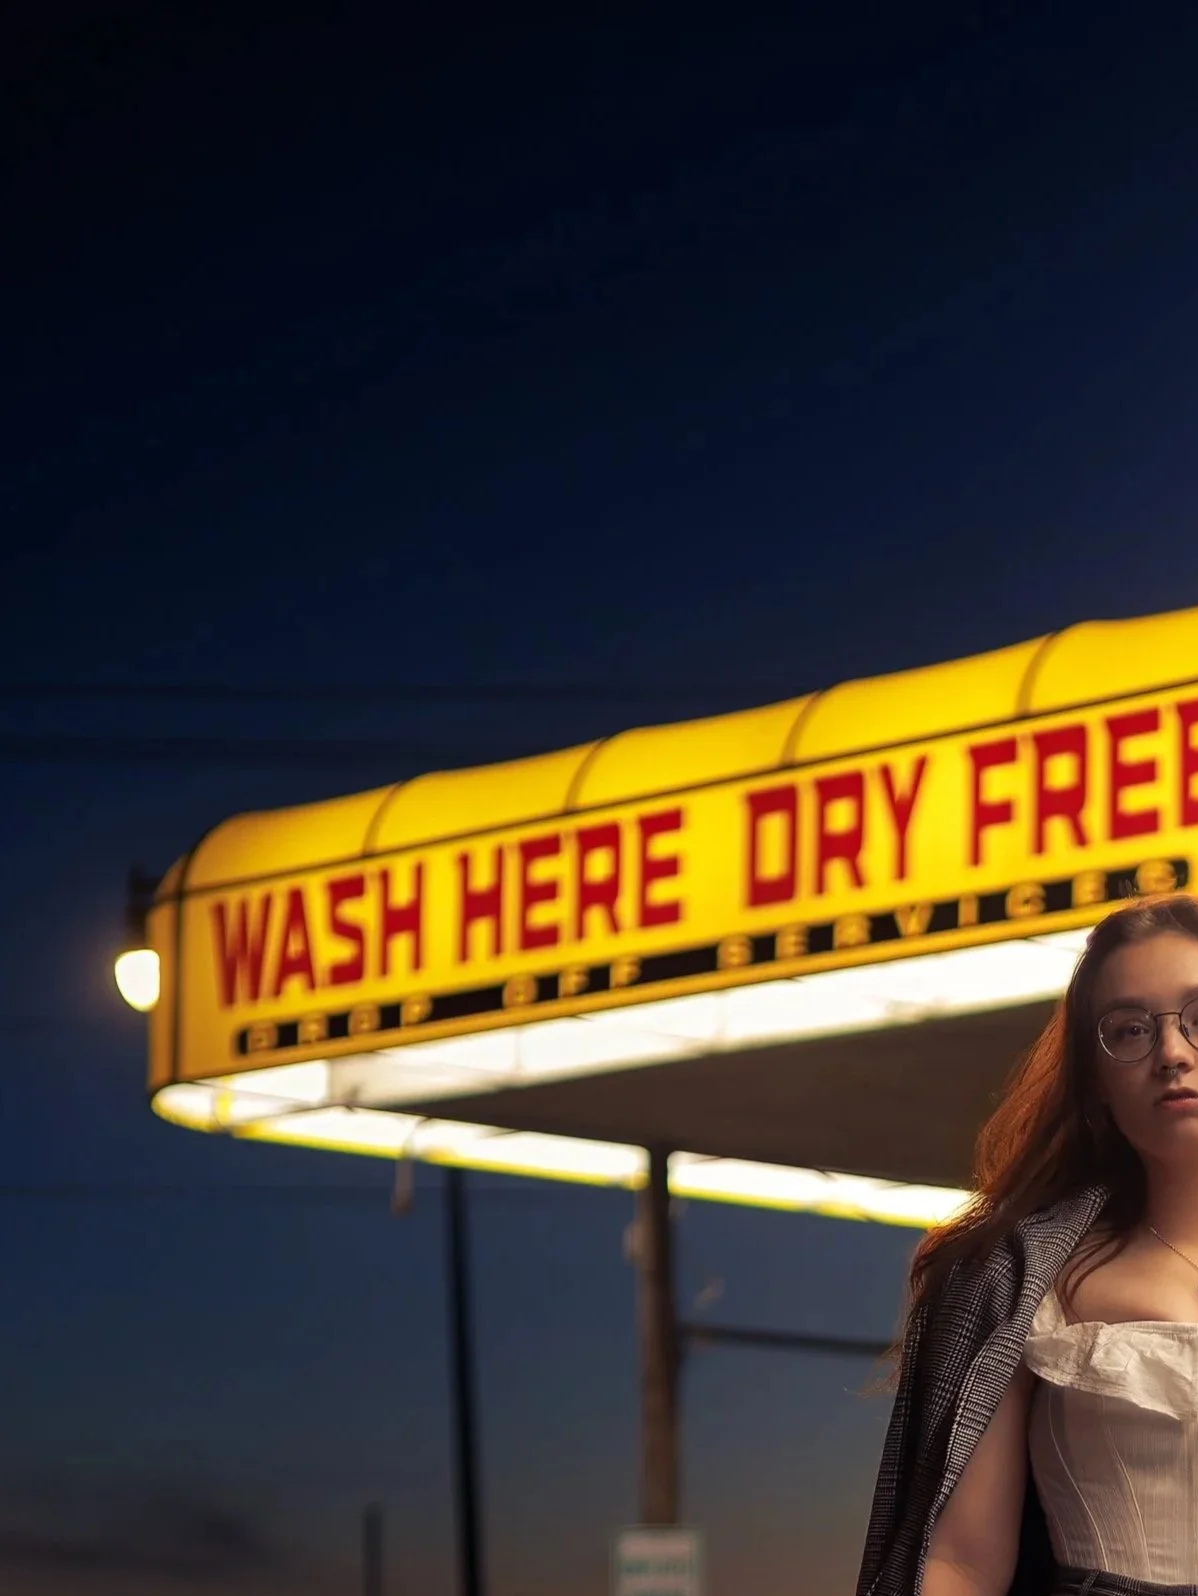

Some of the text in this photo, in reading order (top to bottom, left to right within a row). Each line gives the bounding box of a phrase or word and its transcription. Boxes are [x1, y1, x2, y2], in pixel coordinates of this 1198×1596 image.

[212, 862, 423, 1008] WASH
[458, 808, 684, 964] HERE
[745, 755, 928, 906] DRY
[247, 858, 1178, 1051] DROP OFF SERVICES
